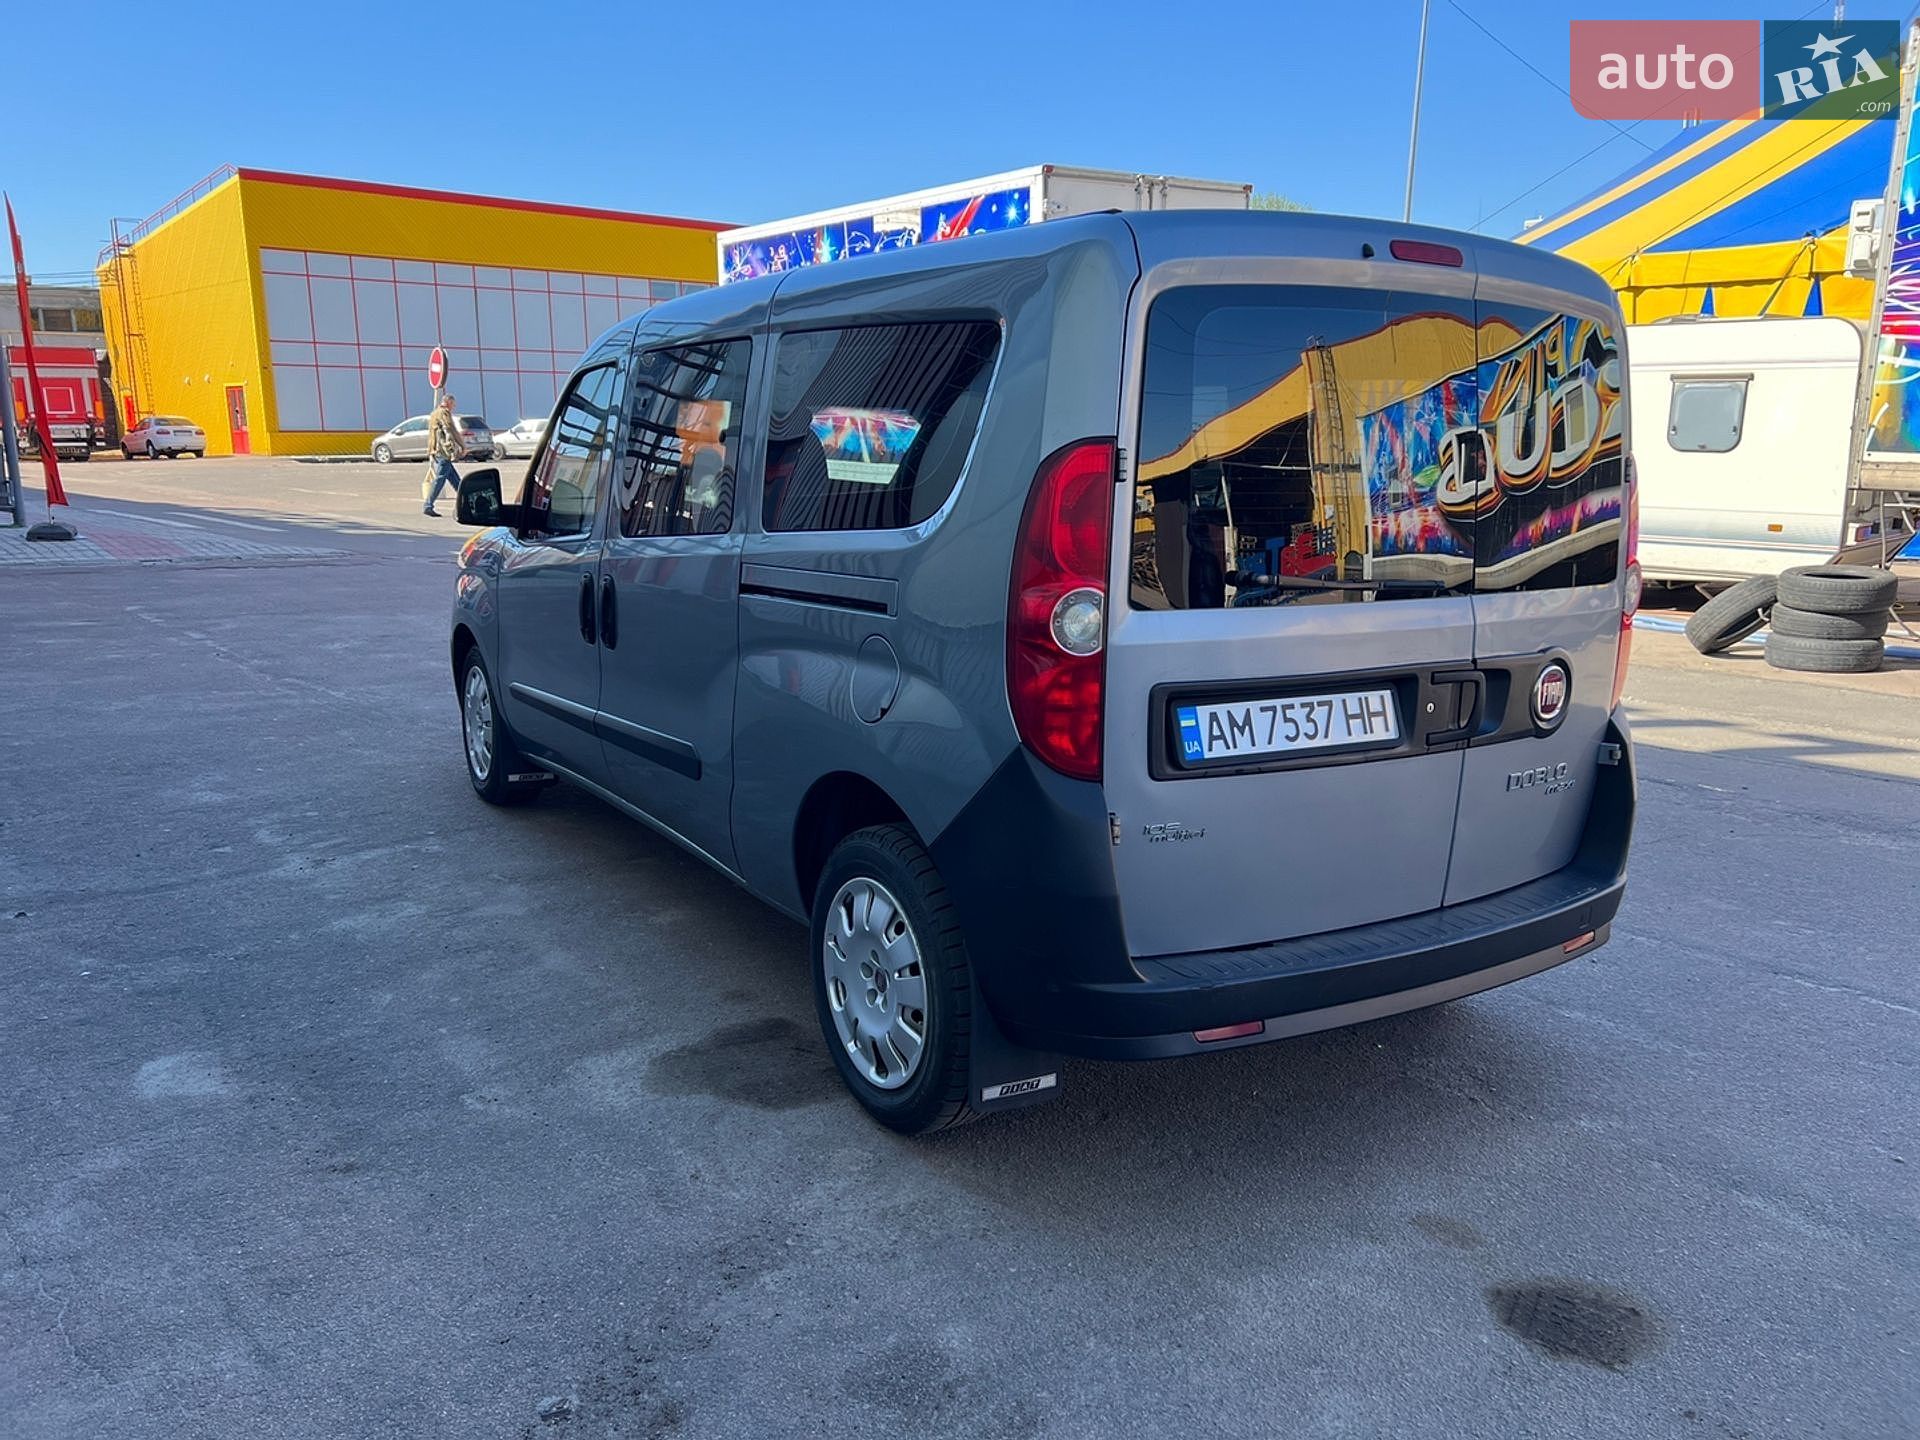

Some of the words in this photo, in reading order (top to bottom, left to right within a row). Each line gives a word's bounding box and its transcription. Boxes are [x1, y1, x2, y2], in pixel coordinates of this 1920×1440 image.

[1541, 681, 1564, 706] FIAT
[1207, 708, 1257, 752] AM
[1260, 699, 1334, 746] 7537
[1342, 695, 1391, 737] HH
[1185, 741, 1201, 754] UA
[1506, 762, 1568, 792] DOBLO
[999, 1078, 1042, 1097] FIAT
